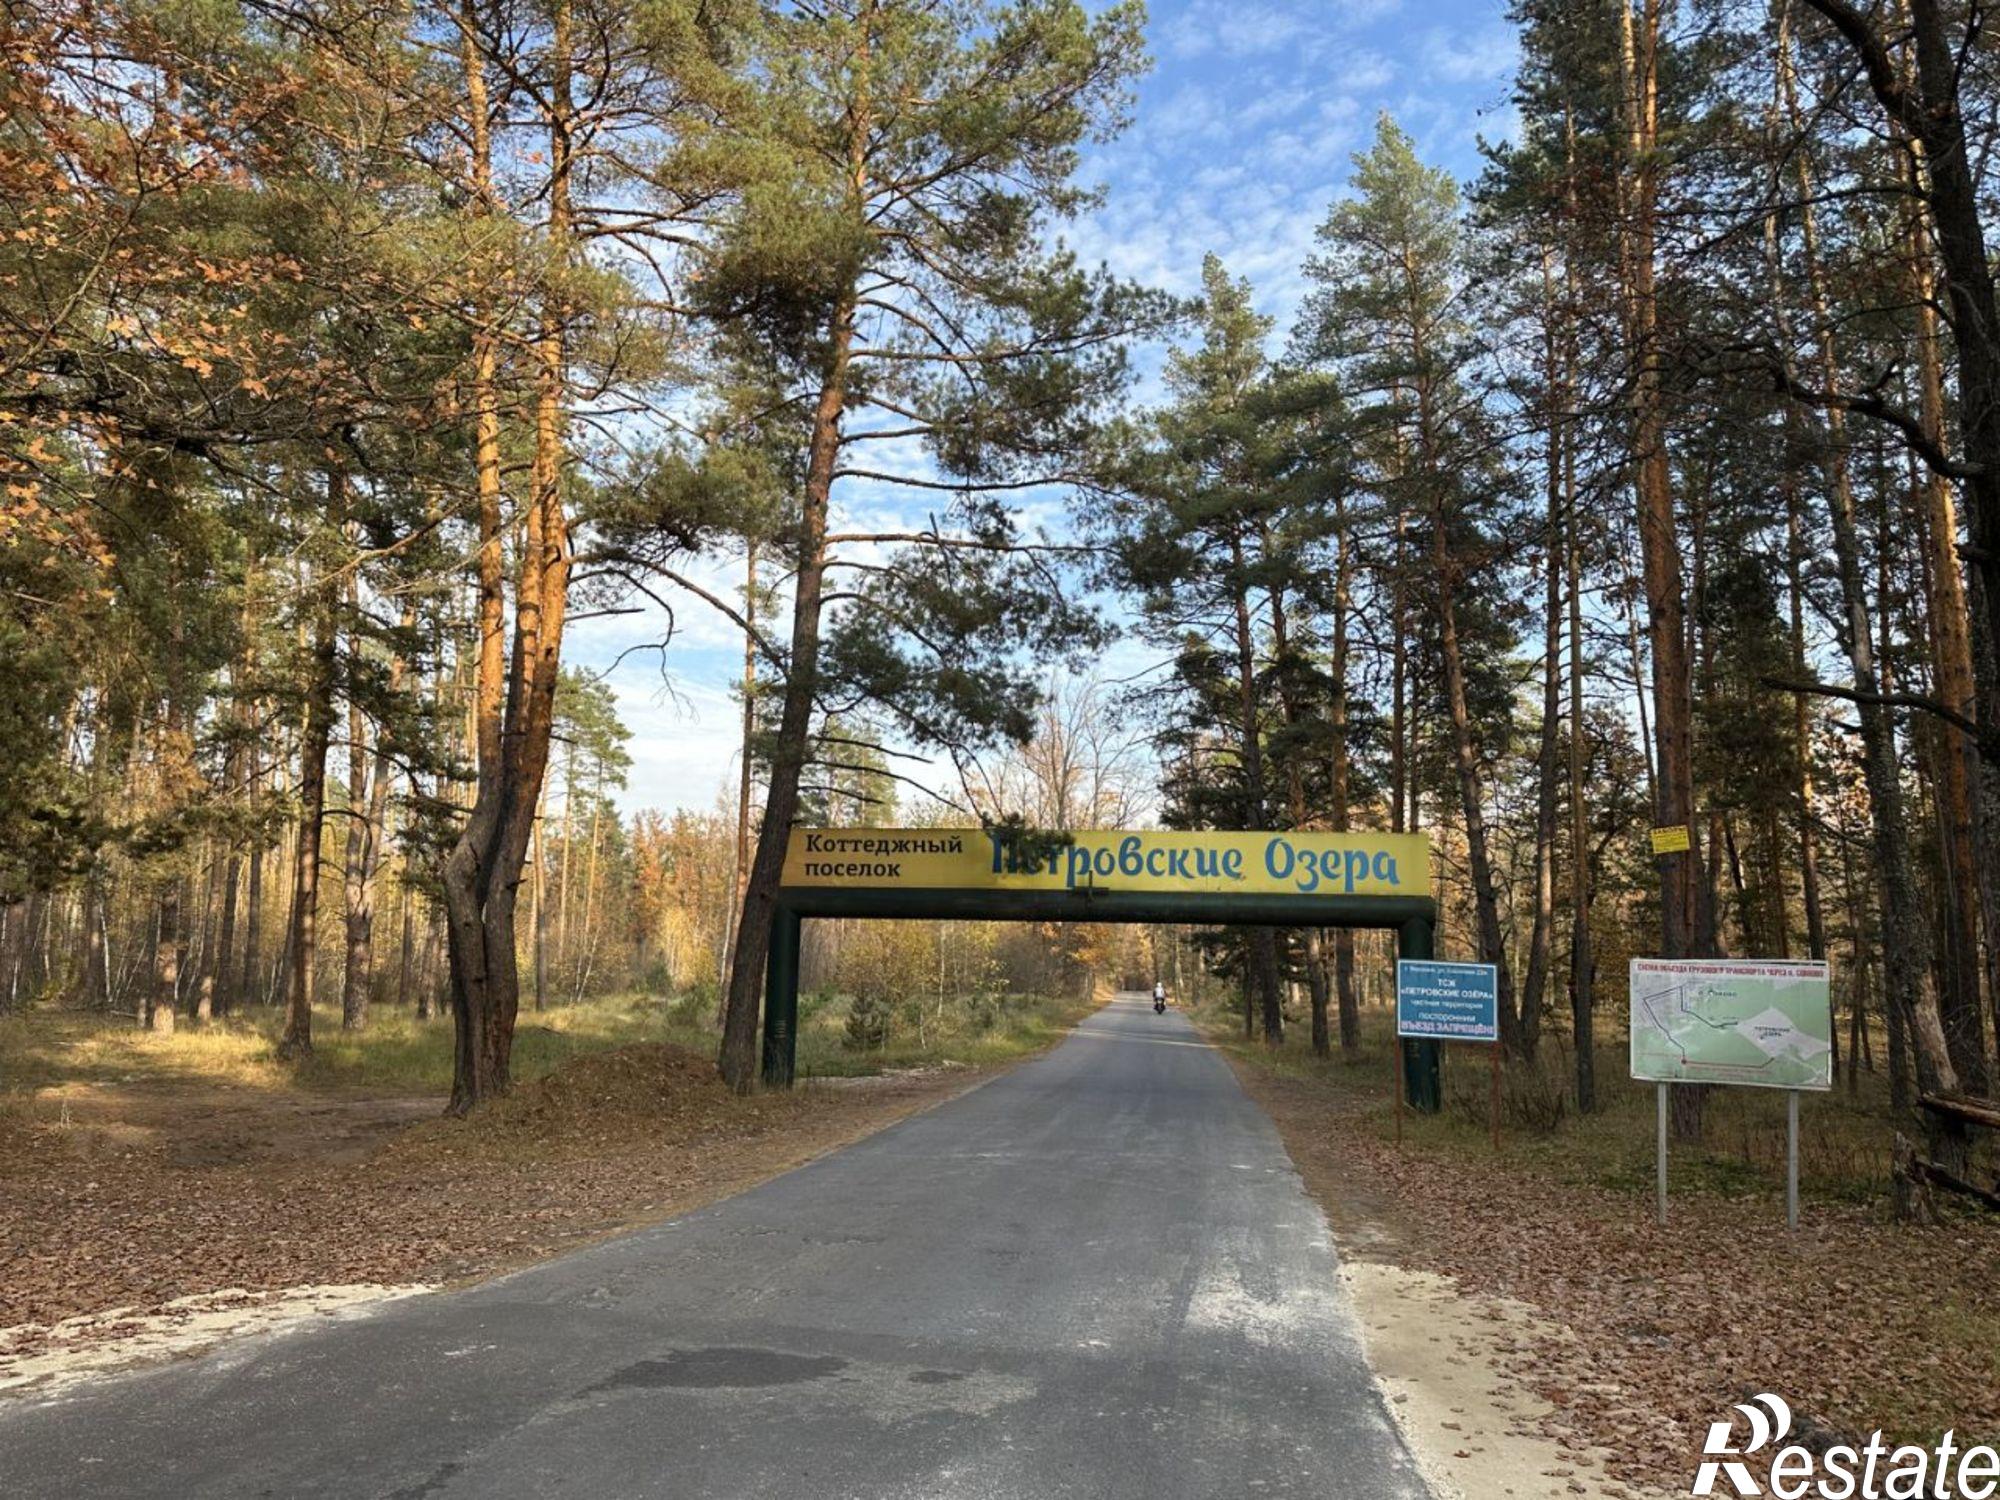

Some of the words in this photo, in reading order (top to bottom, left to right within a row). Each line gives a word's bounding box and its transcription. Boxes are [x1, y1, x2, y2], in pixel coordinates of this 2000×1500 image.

[805, 834, 963, 857] Коттеджный
[804, 862, 901, 877] поселок
[992, 834, 1244, 889] Птровские
[1264, 837, 1401, 893] Озера
